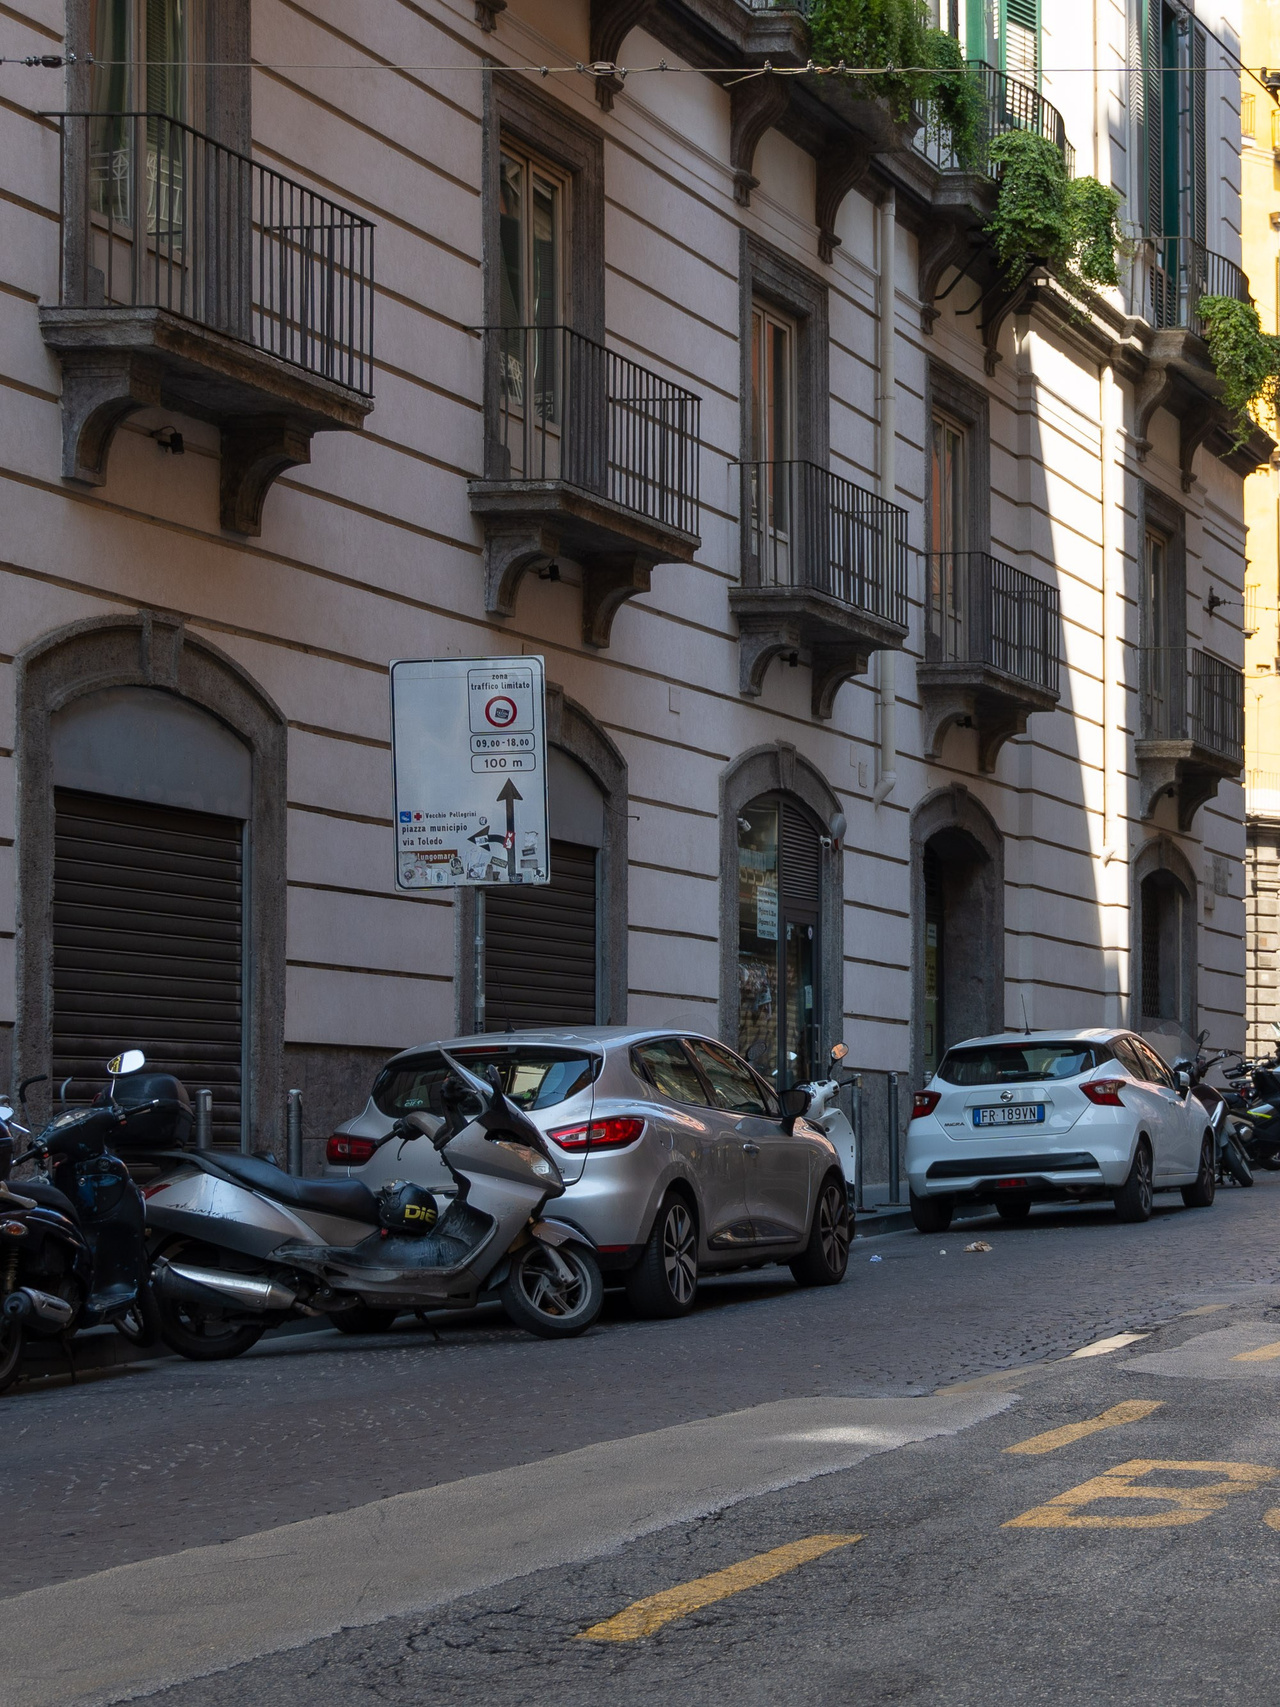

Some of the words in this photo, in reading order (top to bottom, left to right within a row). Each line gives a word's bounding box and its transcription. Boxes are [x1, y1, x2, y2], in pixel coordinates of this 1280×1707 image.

[501, 681, 530, 689] limitato
[484, 758, 507, 768] 100
[402, 825, 426, 834] piazza
[430, 823, 468, 833] municipio
[402, 838, 414, 846] via
[418, 837, 442, 845] Toledo
[981, 1110, 995, 1122] FR
[1001, 1107, 1036, 1121] 189VN
